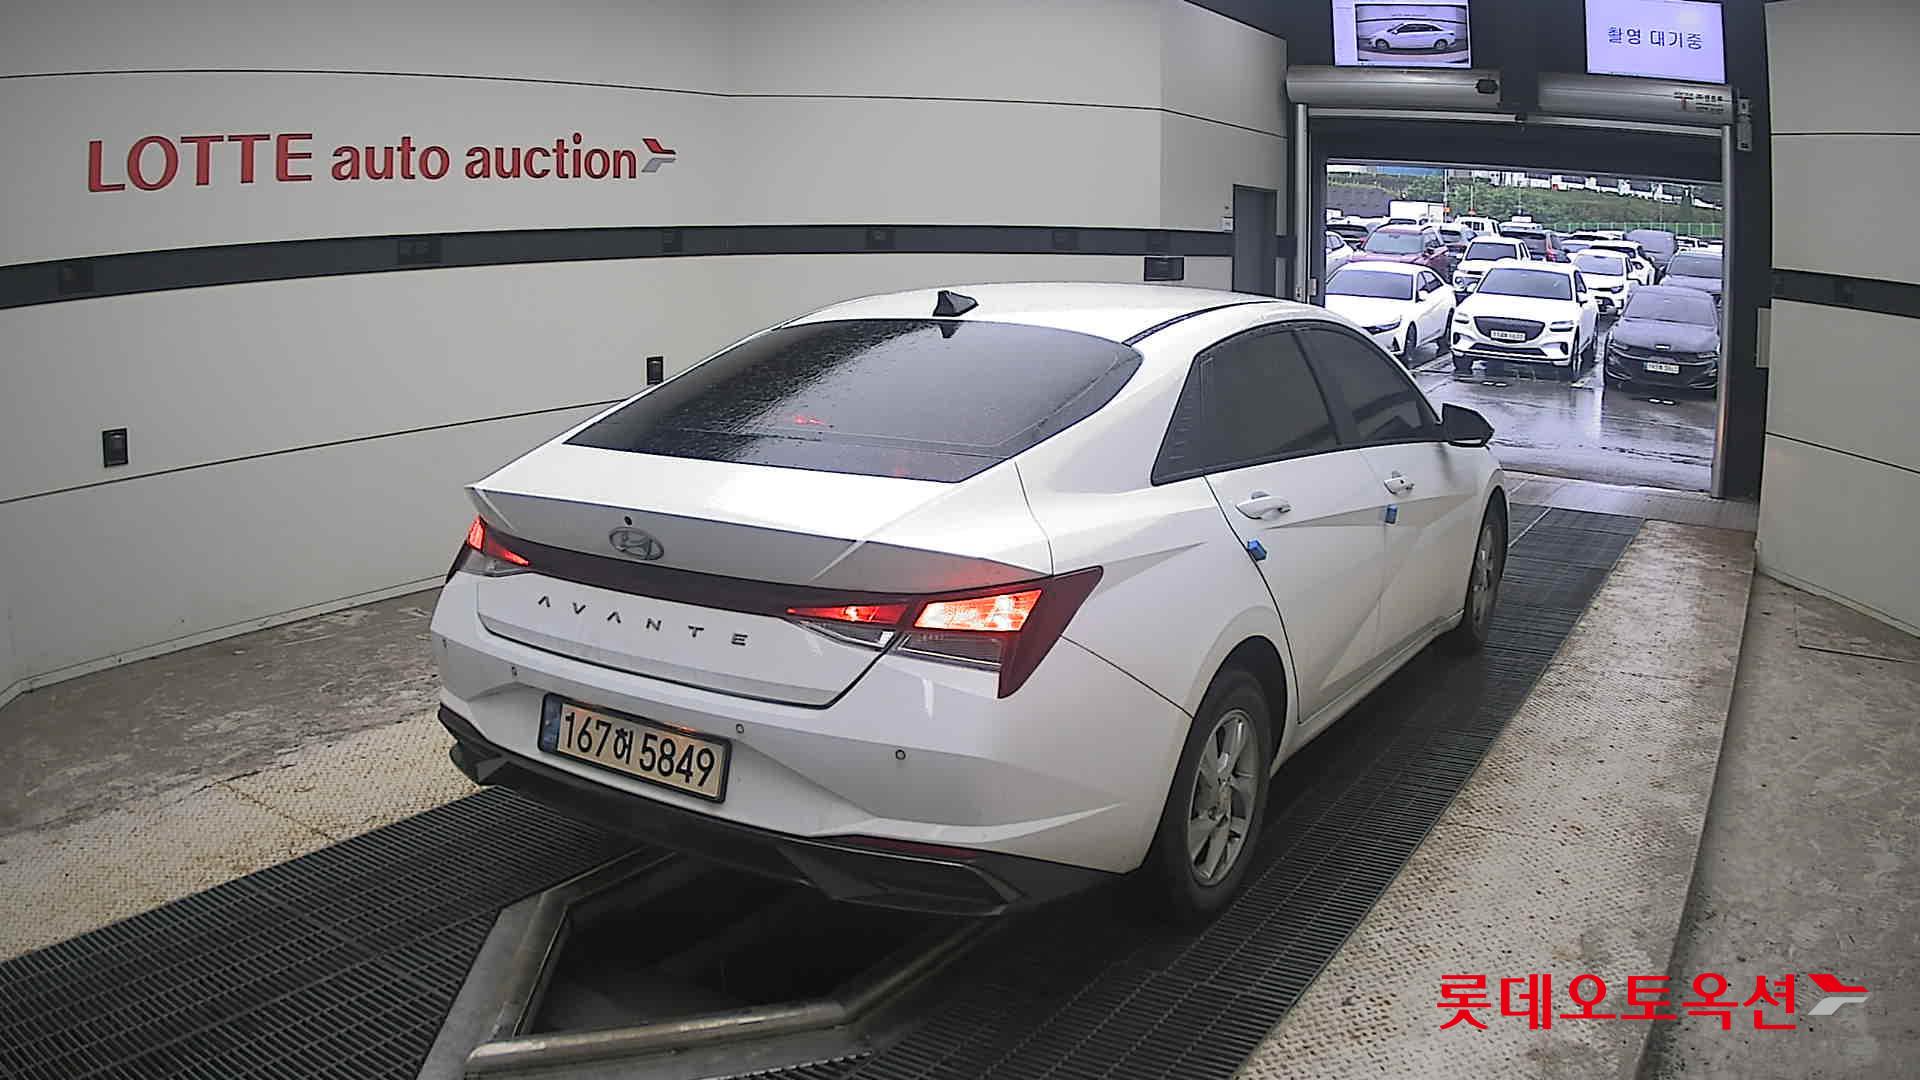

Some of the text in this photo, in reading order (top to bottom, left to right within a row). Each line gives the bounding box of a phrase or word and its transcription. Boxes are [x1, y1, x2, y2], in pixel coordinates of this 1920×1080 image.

[1608, 26, 1703, 50] 촬영 대기중
[87, 132, 638, 193] LOTTE auto auction
[538, 595, 750, 647] AVANTE
[639, 732, 715, 788] 5849
